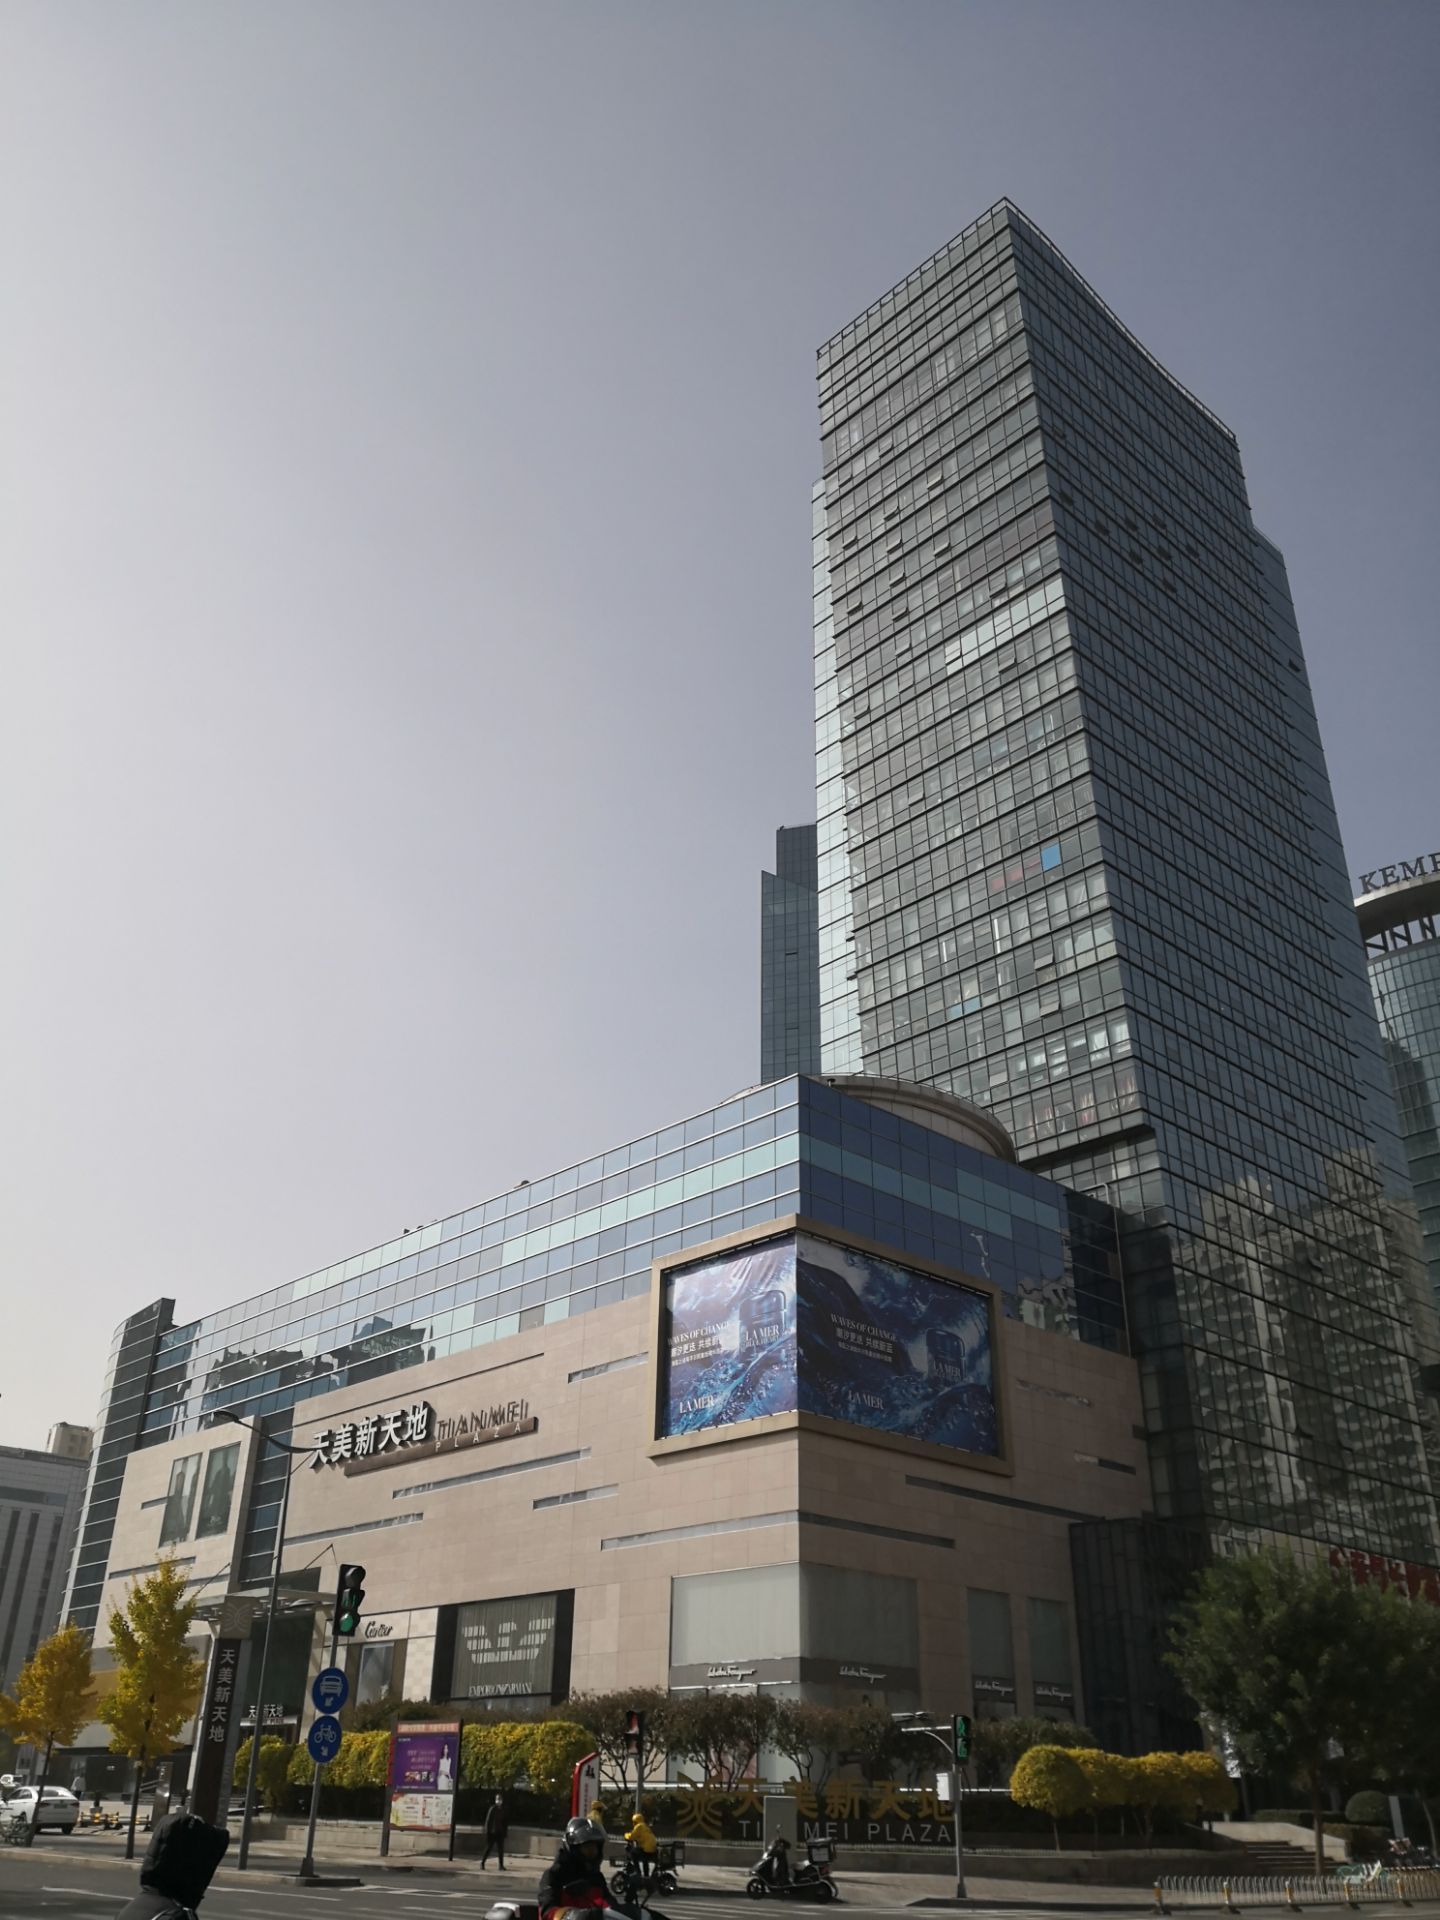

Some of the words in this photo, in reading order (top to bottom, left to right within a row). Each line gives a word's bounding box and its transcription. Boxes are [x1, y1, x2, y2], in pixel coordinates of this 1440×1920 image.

[690, 1328, 700, 1339] OF
[745, 1329, 758, 1341] LA
[759, 1325, 780, 1337] MER
[856, 1322, 867, 1332] OF
[680, 1401, 693, 1414] LA
[693, 1395, 715, 1411] MER
[862, 1394, 884, 1410] MER
[309, 1400, 431, 1470] 天美新天地
[435, 1422, 521, 1452] PLAZA
[208, 1648, 236, 1743] 天美新天地
[248, 1704, 284, 1719] 天新天地
[739, 1820, 849, 1840] TIMEI
[867, 1822, 951, 1842] PLAZA
